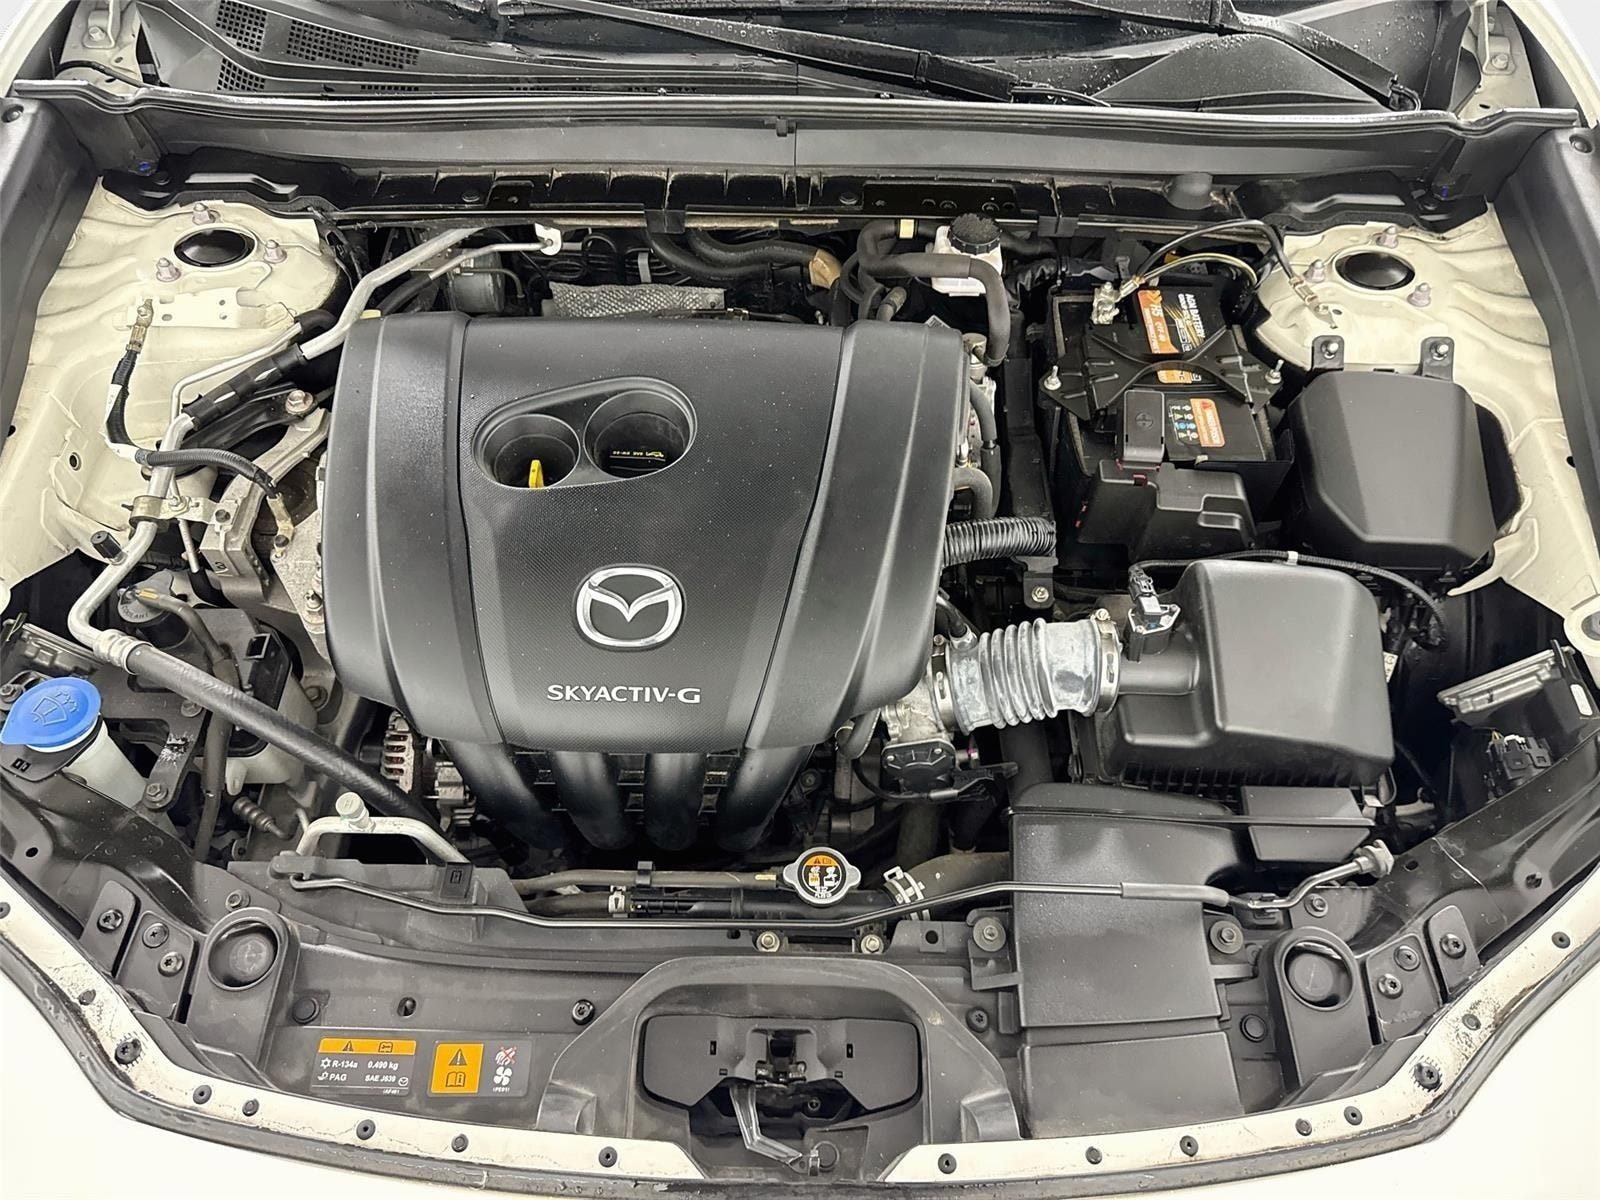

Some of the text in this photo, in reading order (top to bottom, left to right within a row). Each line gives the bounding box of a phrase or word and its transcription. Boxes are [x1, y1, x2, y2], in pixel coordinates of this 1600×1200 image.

[546, 684, 701, 704] SKYACTIV-G
[331, 1060, 358, 1069] R-134a
[388, 1061, 399, 1071] kg
[329, 1073, 347, 1081] PAG
[364, 1074, 380, 1082] SAE
